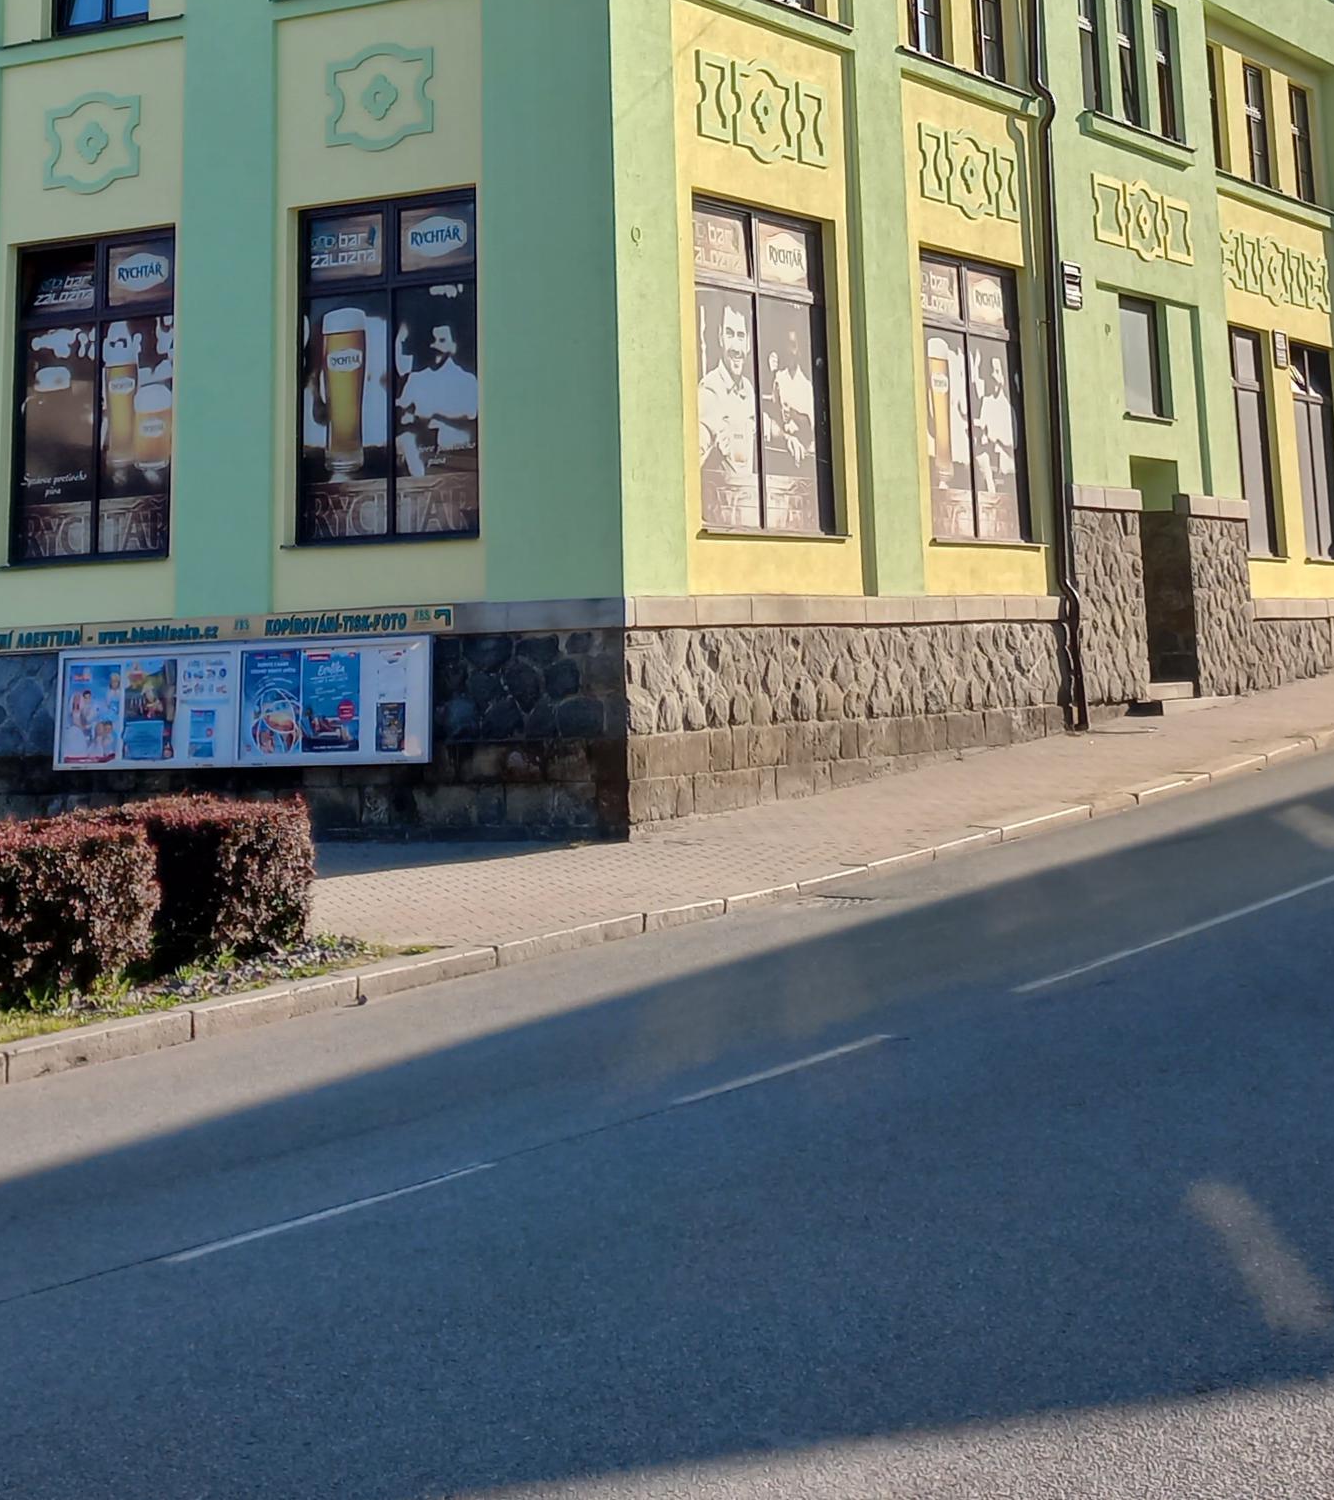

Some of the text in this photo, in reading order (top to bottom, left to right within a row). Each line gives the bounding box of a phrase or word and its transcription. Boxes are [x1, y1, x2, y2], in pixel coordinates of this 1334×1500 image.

[410, 225, 463, 247] RYCHTÁŘ
[768, 243, 806, 273] RYCHTÁŘ
[117, 261, 165, 283] RYCHTÁŘ
